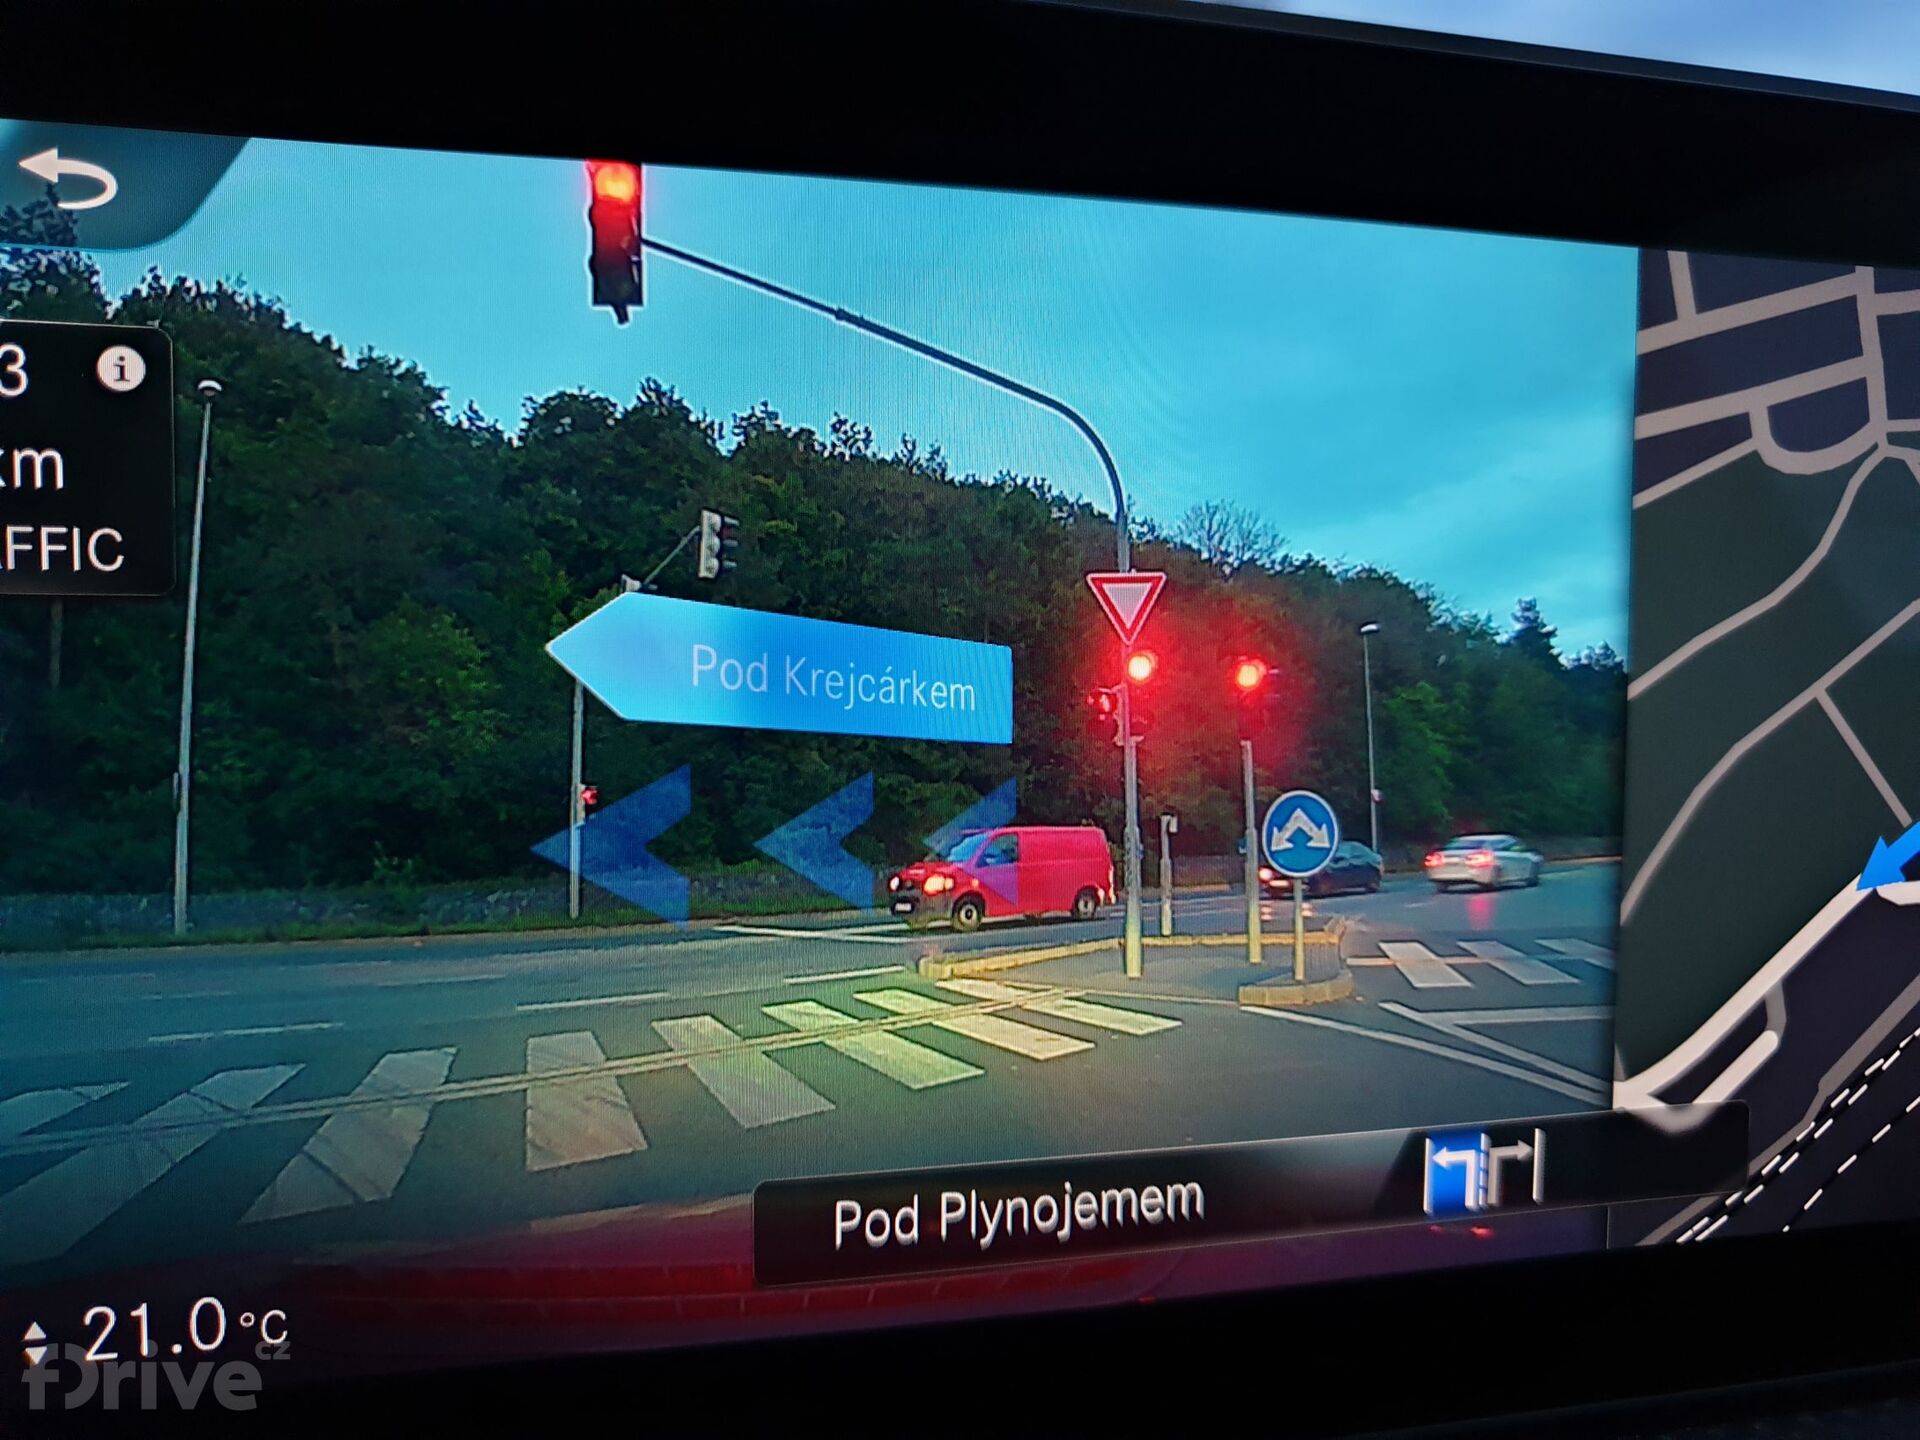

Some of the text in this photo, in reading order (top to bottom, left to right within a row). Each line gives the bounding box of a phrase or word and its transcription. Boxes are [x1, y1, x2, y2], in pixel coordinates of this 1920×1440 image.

[0, 447, 64, 490] m
[0, 524, 125, 572] FFIC
[692, 643, 976, 712] Pod Krejcárkem
[836, 1181, 1205, 1252] Pod Plynojemem
[83, 1296, 228, 1362] 21.0
